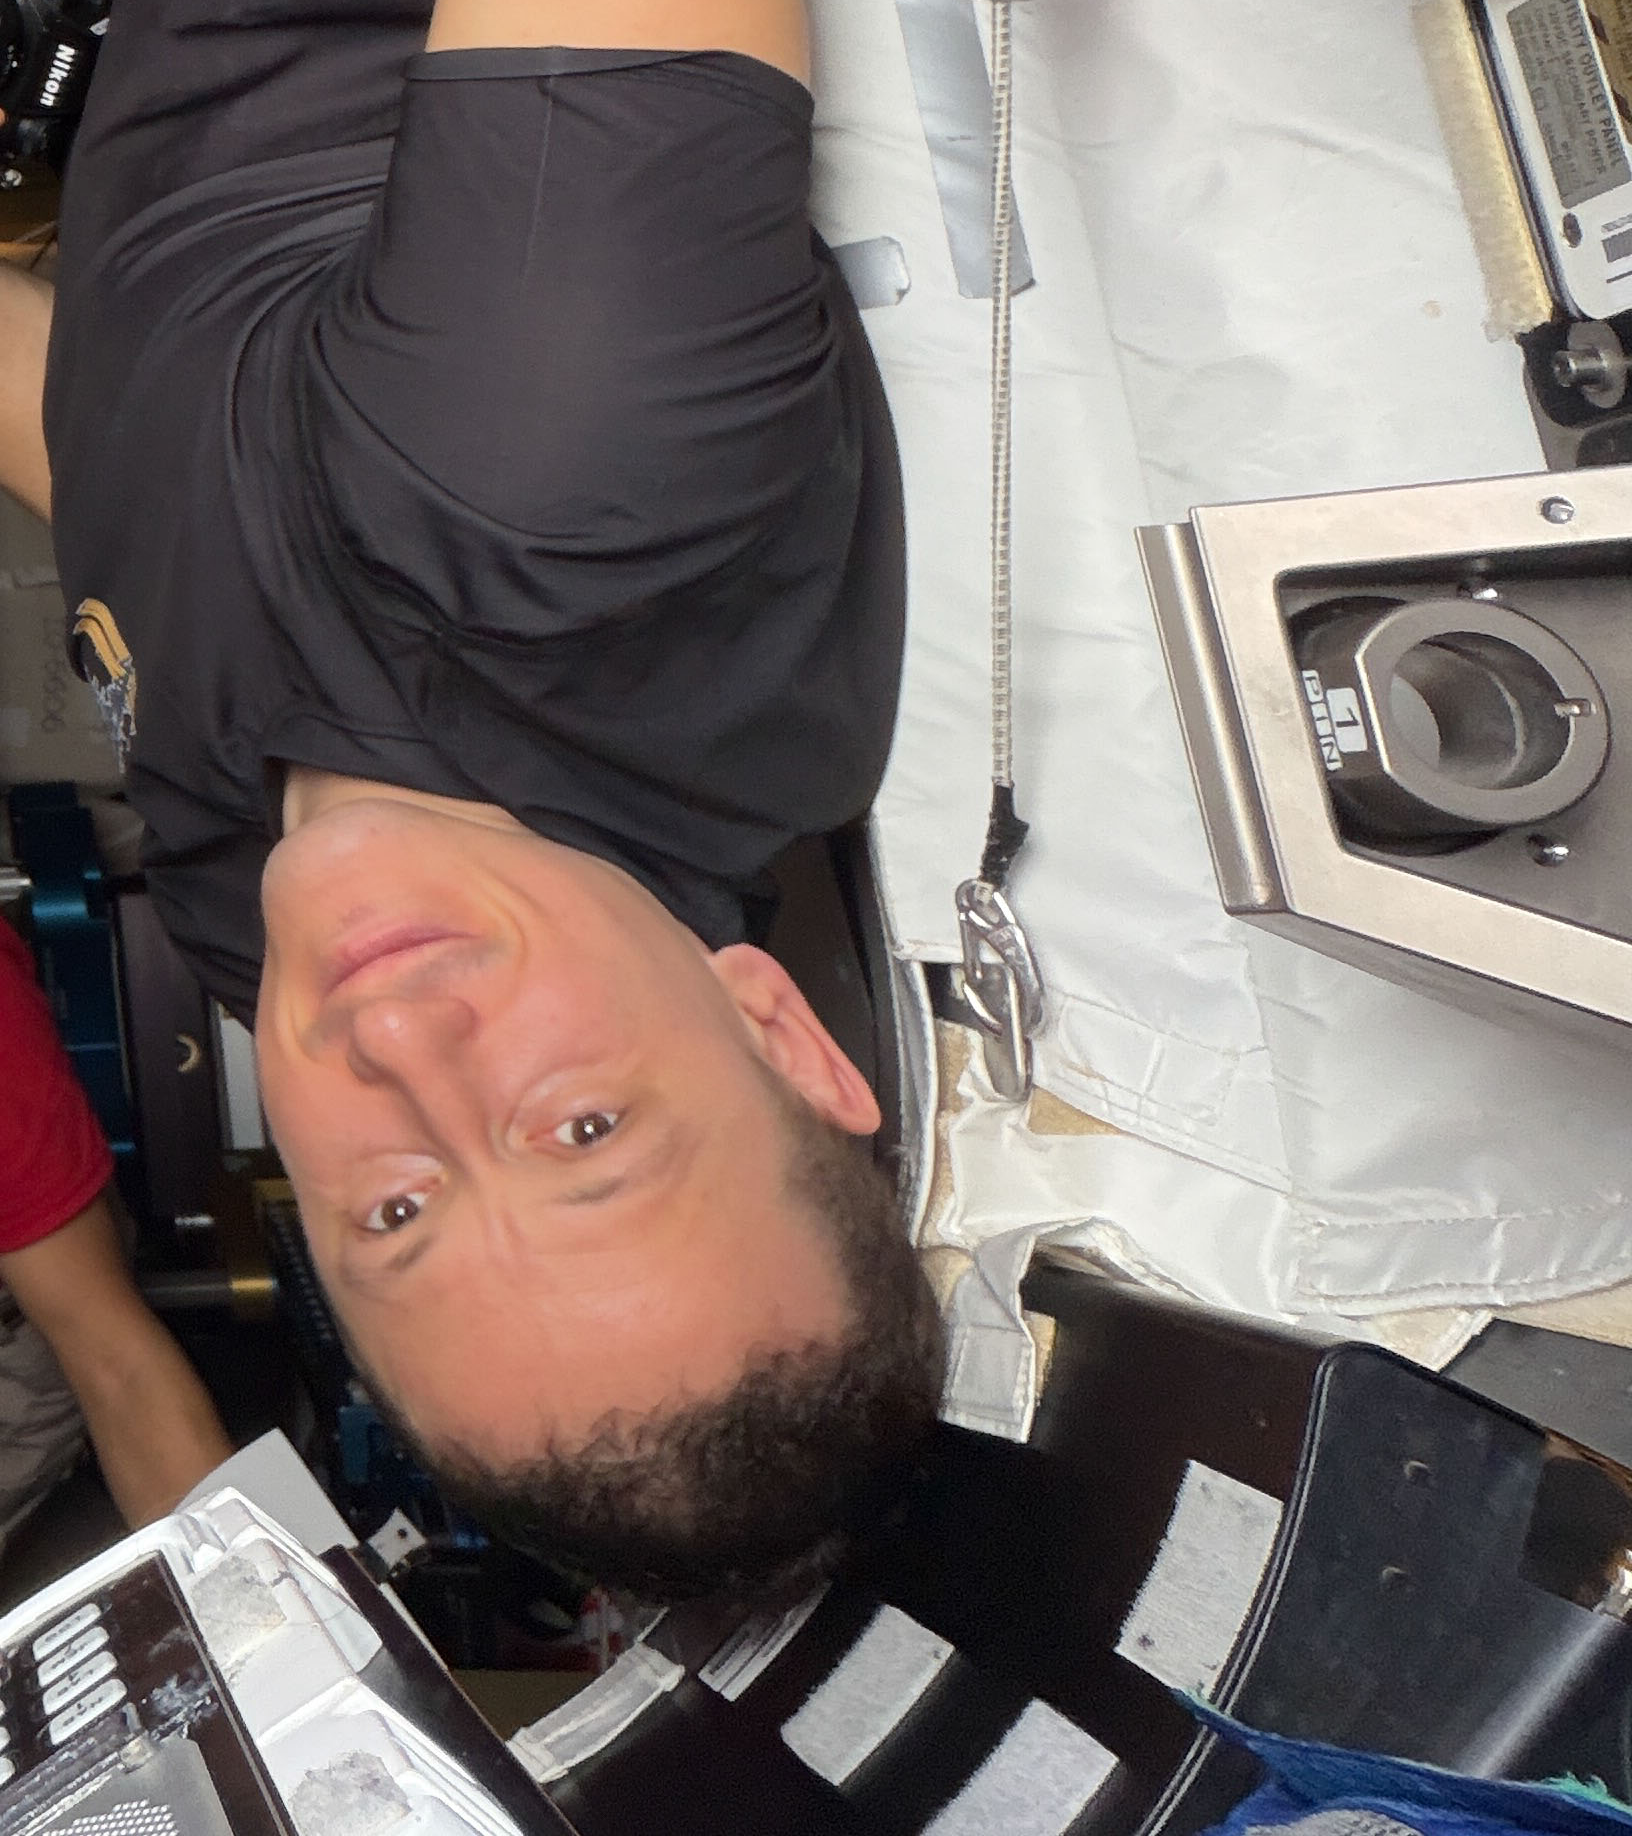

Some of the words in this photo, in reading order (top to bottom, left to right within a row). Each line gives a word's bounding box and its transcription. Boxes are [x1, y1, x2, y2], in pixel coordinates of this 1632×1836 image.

[38, 42, 77, 108] Nikon
[1580, 51, 1610, 113] OUTLET
[1599, 116, 1624, 168] PANEL
[1304, 675, 1339, 764] PIN
